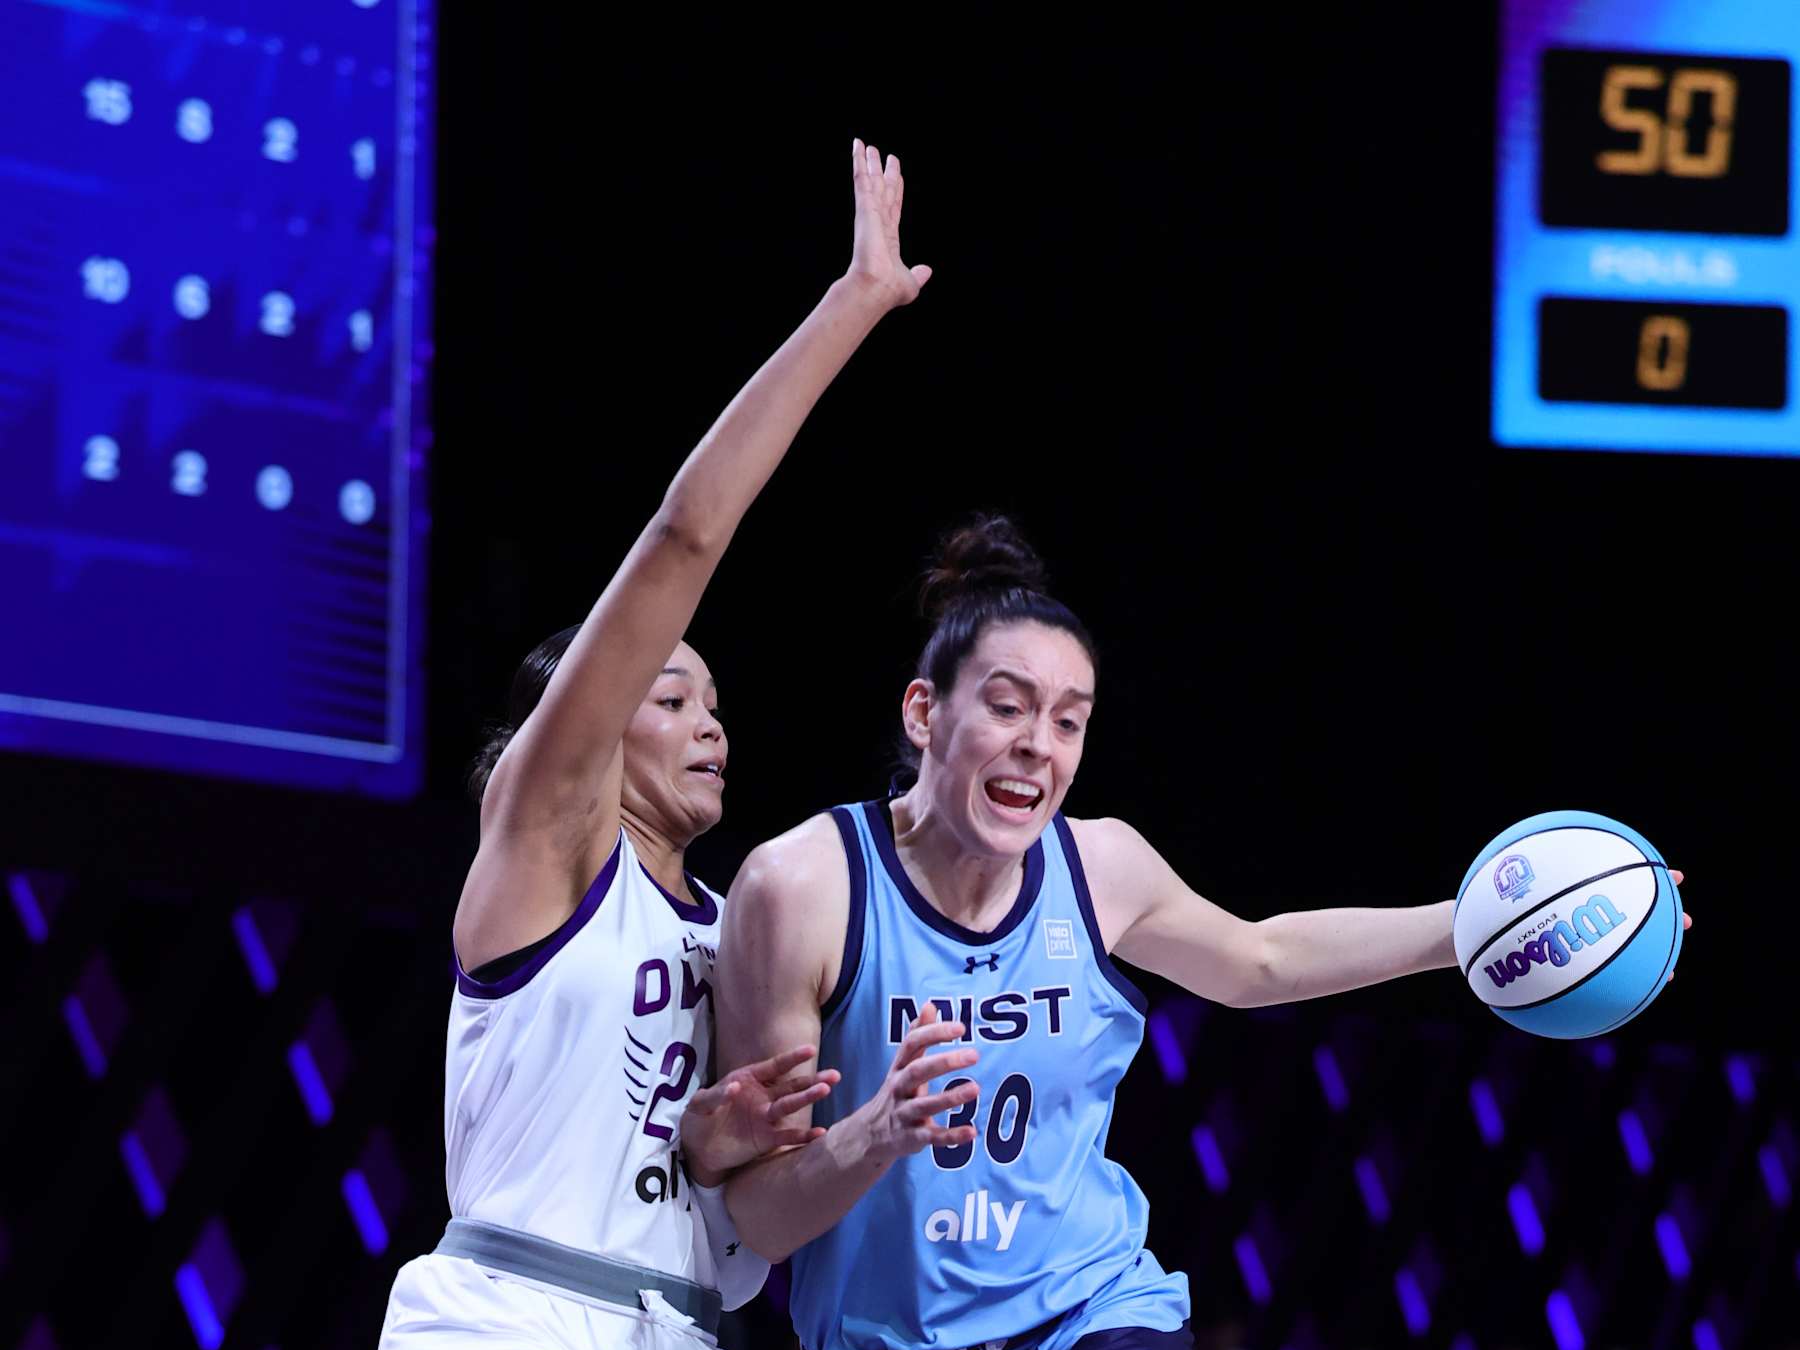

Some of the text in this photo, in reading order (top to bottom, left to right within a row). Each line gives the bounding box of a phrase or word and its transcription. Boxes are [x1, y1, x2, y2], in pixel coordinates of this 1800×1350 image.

[1596, 64, 1737, 178] 50
[1635, 315, 1691, 391] 0
[1484, 894, 1628, 988] Wilson
[1517, 913, 1558, 944] EVO NXT
[633, 959, 715, 1017] OW
[887, 985, 1073, 1045] MIST
[931, 1073, 1034, 1172] 30
[925, 1190, 1027, 1251] ally
